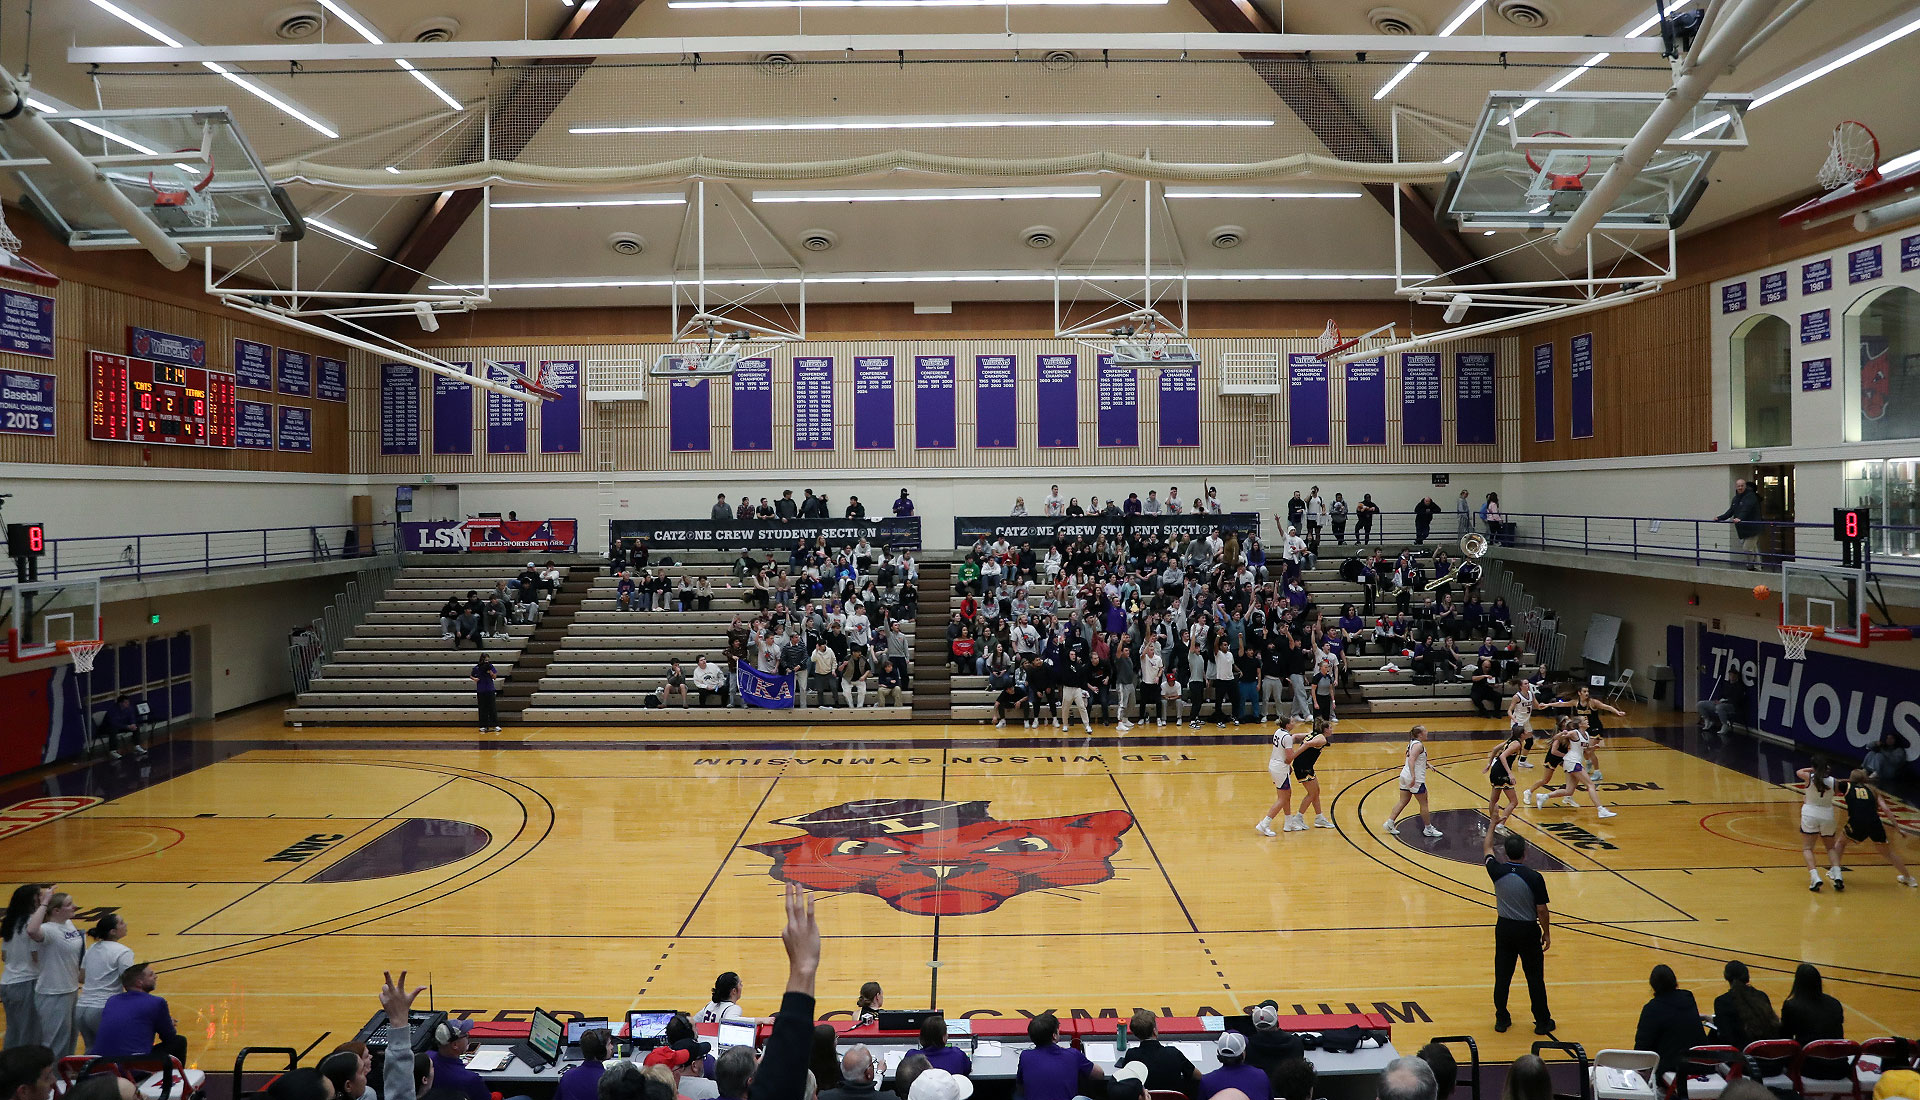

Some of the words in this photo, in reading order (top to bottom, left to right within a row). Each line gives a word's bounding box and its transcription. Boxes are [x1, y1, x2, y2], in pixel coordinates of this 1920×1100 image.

[1766, 280, 1782, 290] Football
[1810, 281, 1824, 292] 1981
[1767, 292, 1780, 302] 1965
[5, 306, 20, 316] Track
[26, 310, 39, 319] Field
[21, 318, 37, 327] Cross
[20, 332, 51, 343] CHAMPION
[151, 338, 190, 360] WILDCATS
[737, 360, 766, 368] WILDCATS
[799, 359, 828, 368] WILDCATS
[860, 359, 888, 367] WILDCATS
[921, 358, 949, 367] WILDCATS
[982, 357, 1011, 366] WILDCATS
[1042, 357, 1071, 365] WILDCATS
[165, 366, 185, 384] 1:14
[3, 388, 43, 403] Baseball
[185, 388, 206, 399] TITANS
[20, 404, 54, 413] CHAMPIONS
[140, 393, 152, 411] 10
[167, 397, 173, 412] 2
[193, 399, 204, 416] 18
[6, 412, 39, 430] 2013
[136, 417, 144, 432] 3
[149, 420, 156, 432] 4
[185, 423, 191, 435] 4
[197, 423, 204, 437] 3
[1057, 525, 1097, 536] CREW
[1846, 512, 1858, 538] 8
[418, 528, 472, 549] LSN
[715, 529, 755, 540] CREW
[758, 528, 818, 540] STUDENT
[821, 527, 877, 539] SECTION
[503, 540, 530, 548] SPORTS
[1711, 647, 1758, 687] The
[693, 757, 932, 766] GYMNASIUM
[951, 754, 1103, 764] WILSON
[1121, 754, 1197, 762] TED
[1537, 822, 1620, 851] NWC
[263, 833, 345, 863] NWC
